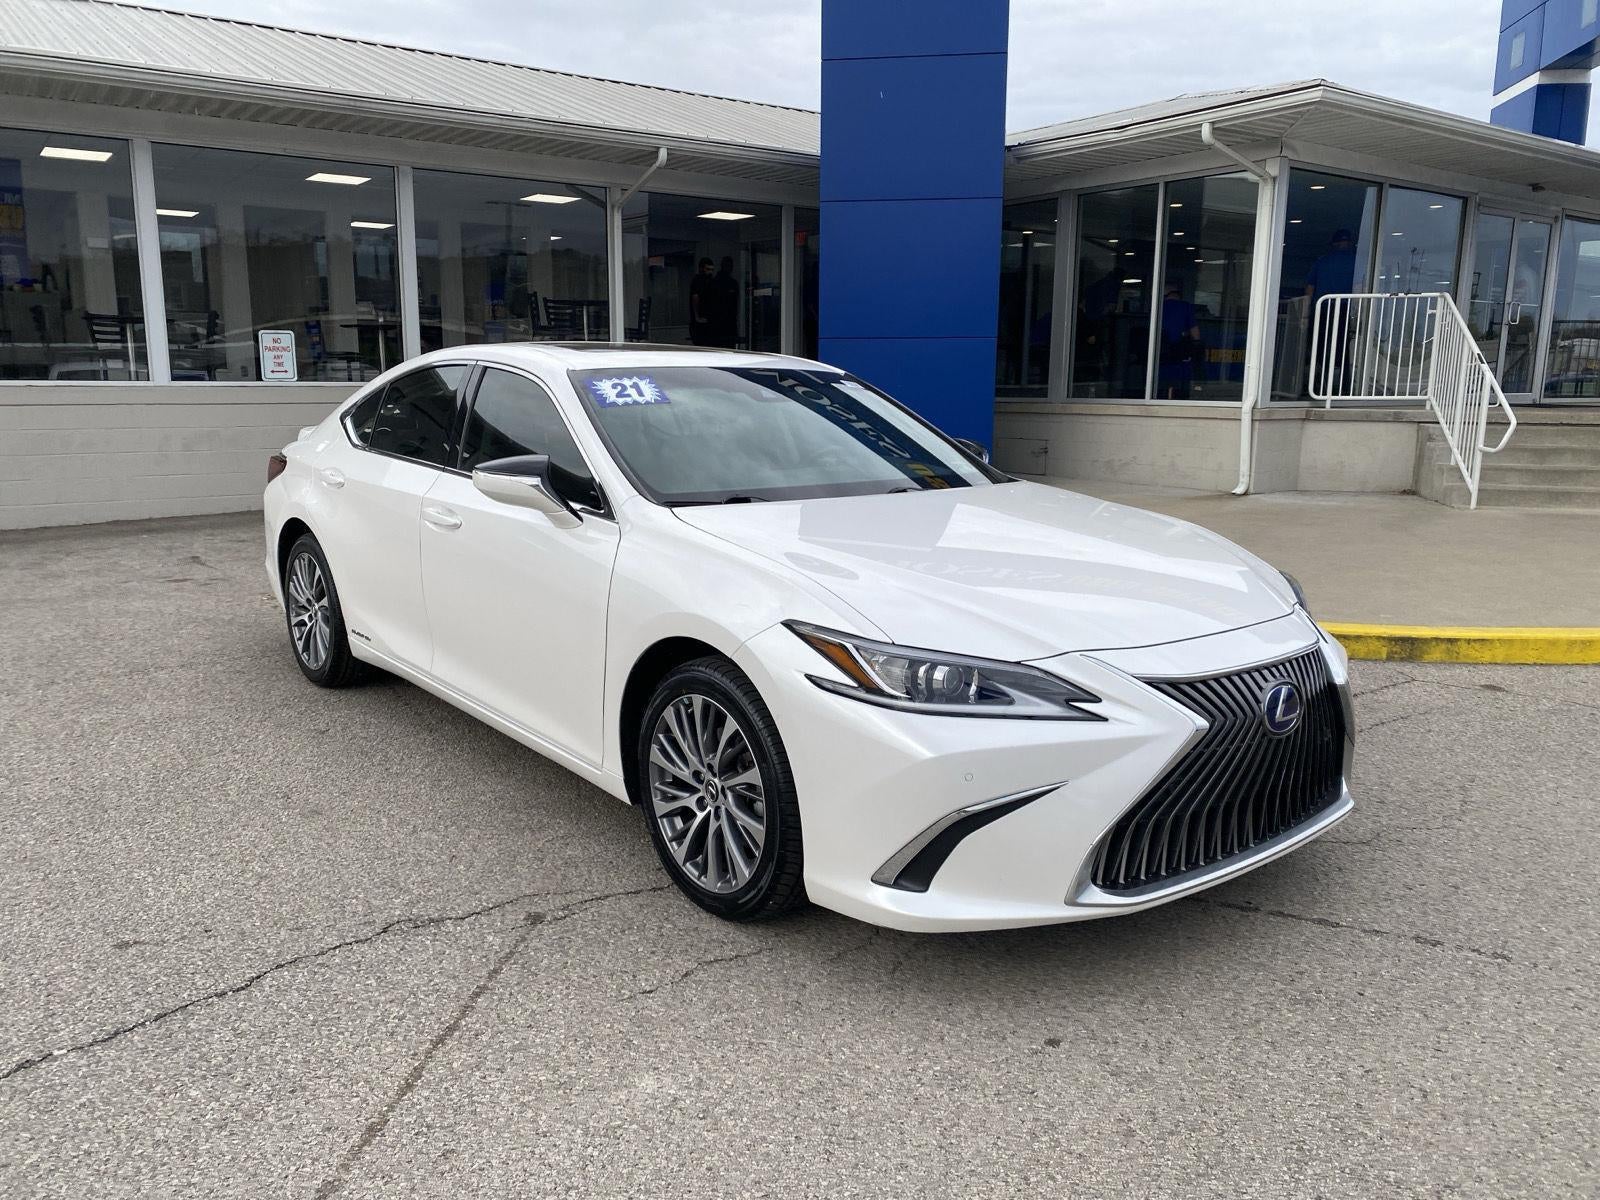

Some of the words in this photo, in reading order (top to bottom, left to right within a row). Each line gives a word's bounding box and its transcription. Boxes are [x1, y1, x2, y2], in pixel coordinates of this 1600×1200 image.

[272, 337, 282, 345] NO
[264, 345, 291, 353] PARKING
[611, 381, 646, 399] 21
